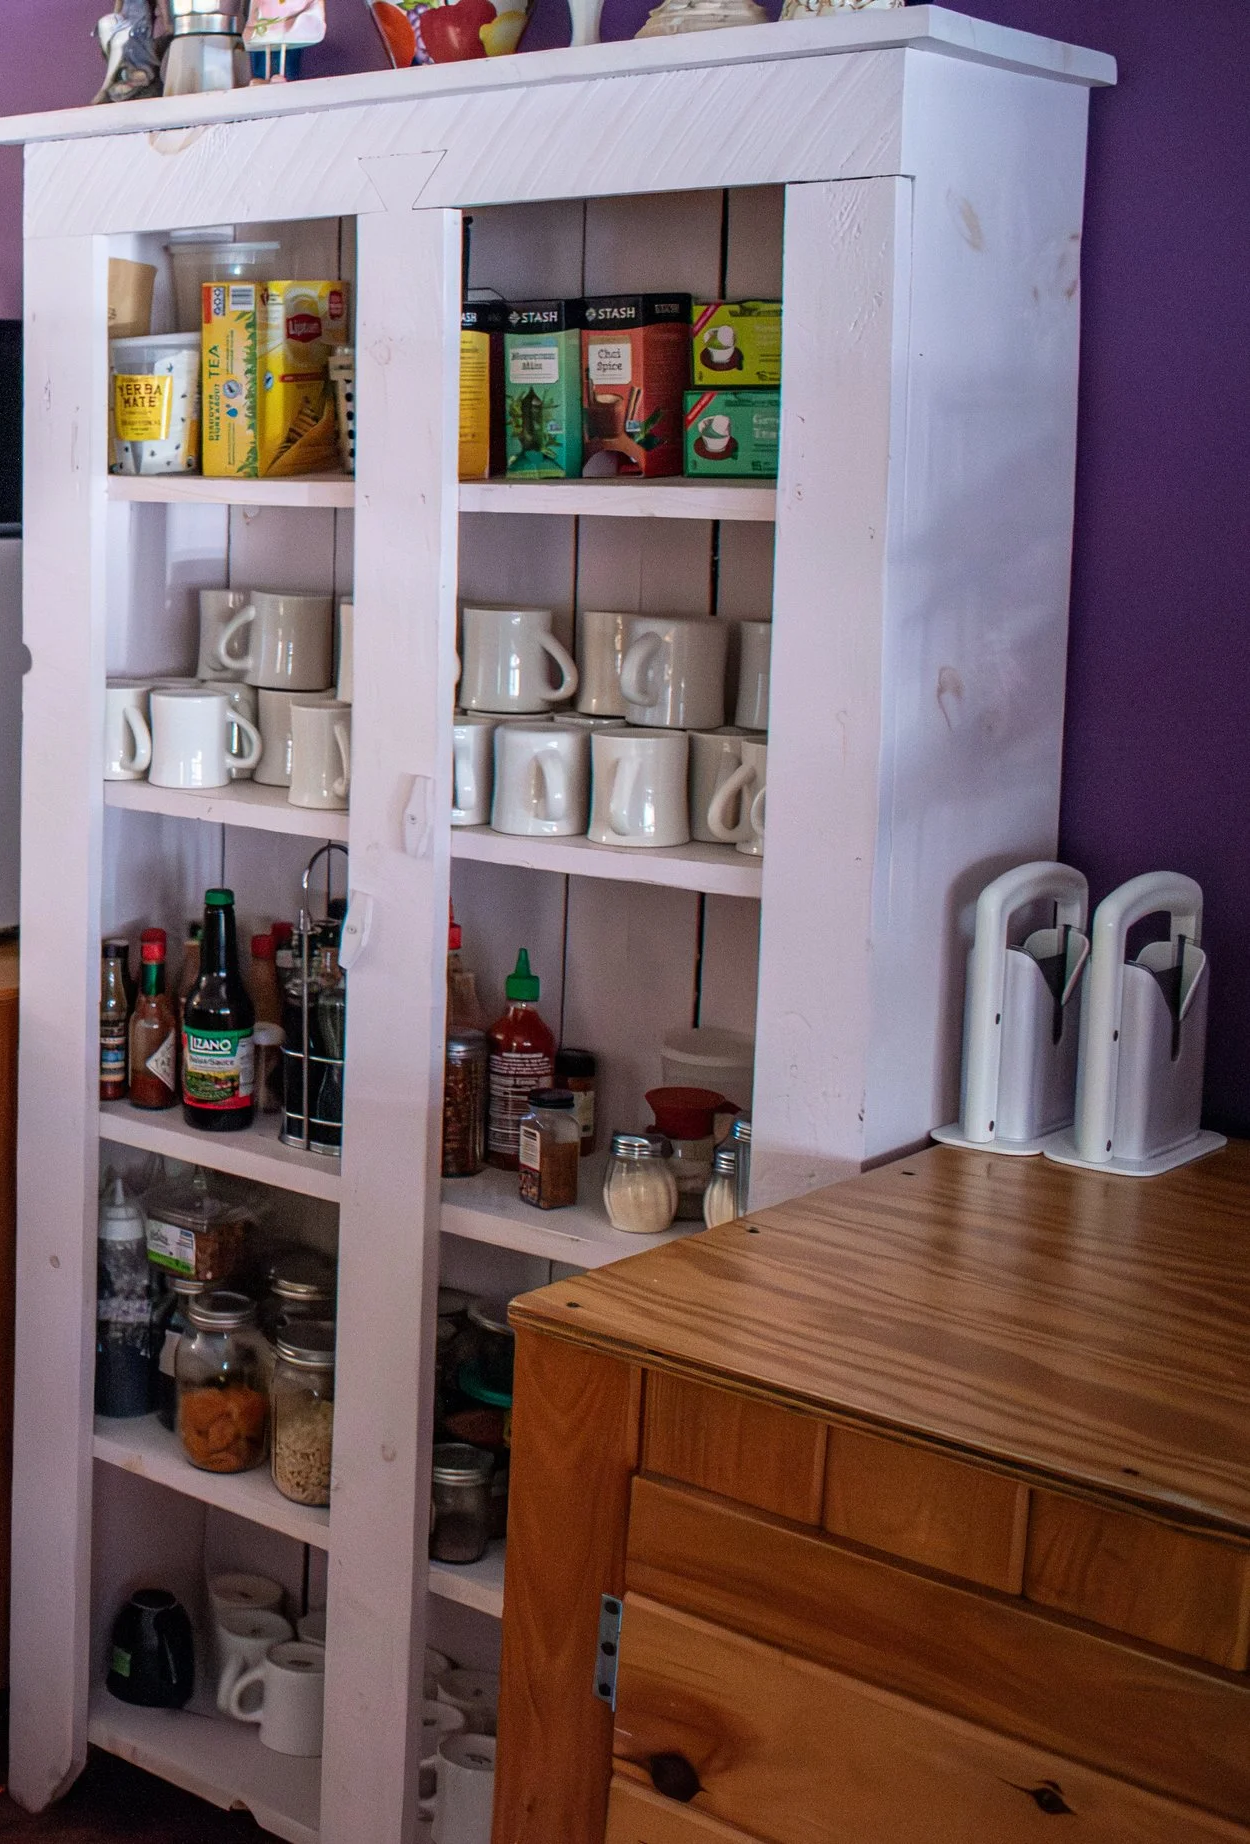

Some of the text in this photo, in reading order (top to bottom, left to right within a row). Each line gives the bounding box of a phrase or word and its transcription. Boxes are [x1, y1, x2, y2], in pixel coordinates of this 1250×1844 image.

[461, 312, 477, 323] ASH
[521, 311, 558, 323] STASH
[598, 307, 635, 319] STASH
[598, 348, 621, 359] Chai
[208, 344, 220, 379] TEA
[596, 361, 623, 373] Spice
[117, 383, 163, 397] YERBA
[123, 396, 157, 408] MATE
[190, 1034, 232, 1053] LIZANO
